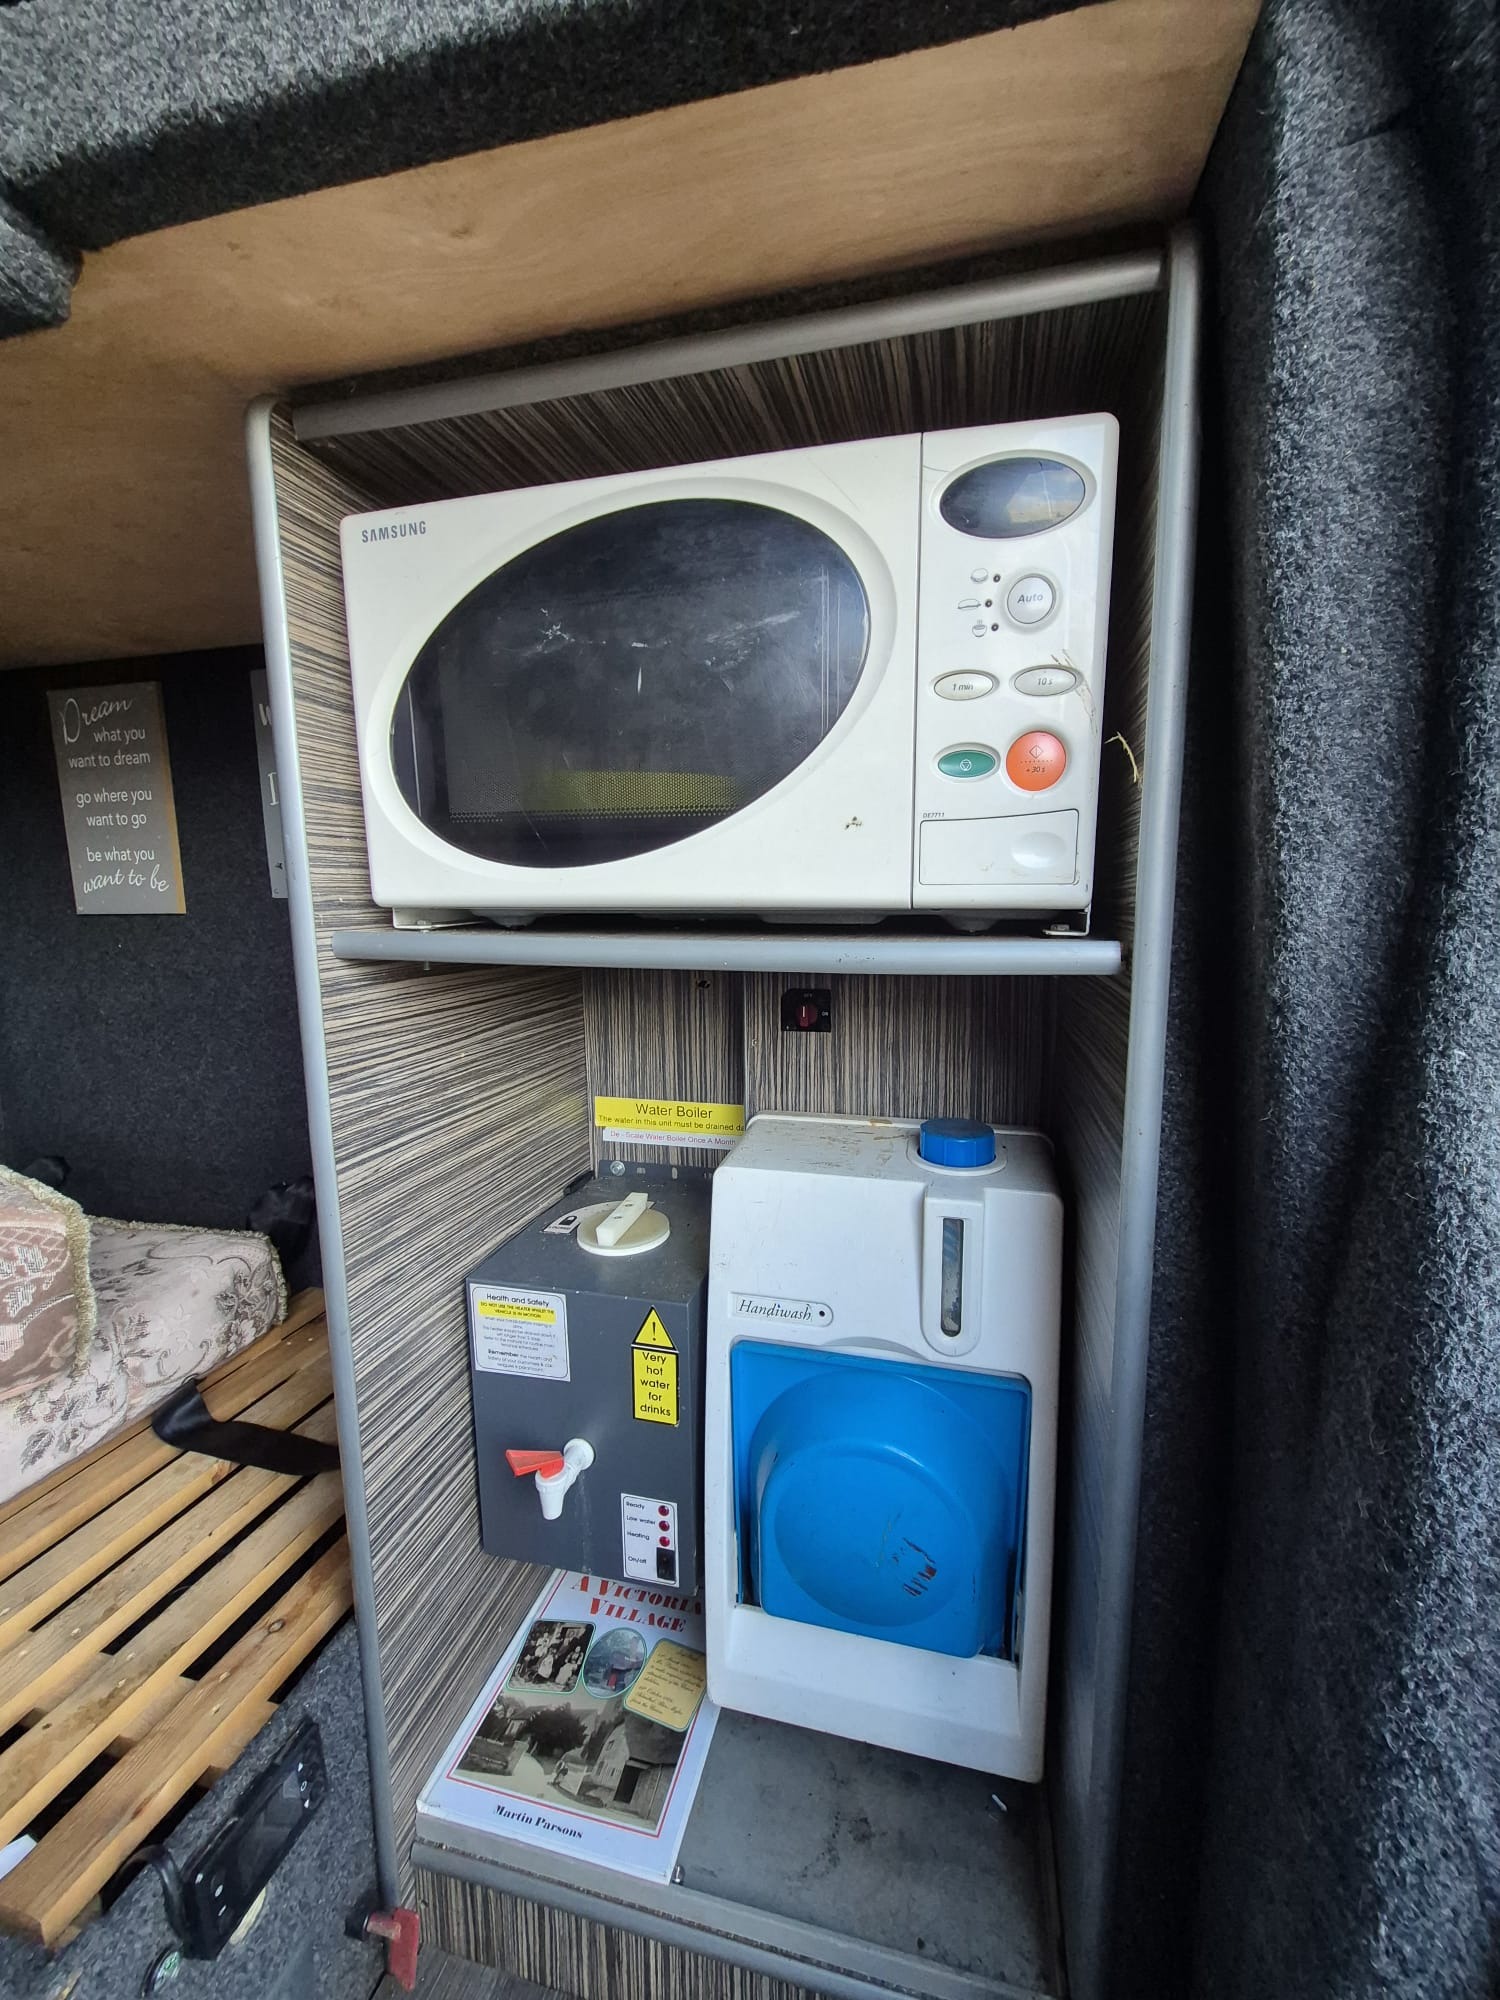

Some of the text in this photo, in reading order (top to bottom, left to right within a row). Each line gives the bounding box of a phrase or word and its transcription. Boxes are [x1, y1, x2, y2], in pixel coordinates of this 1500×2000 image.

[362, 520, 426, 543] SAMSUNG
[1017, 593, 1044, 604] Auto
[958, 683, 974, 692] min
[1038, 677, 1046, 686] 10
[59, 698, 133, 744] Dream
[93, 727, 146, 744] what you
[68, 748, 151, 768] want to dream
[76, 787, 152, 808] go where you
[86, 812, 147, 828] want to go
[86, 845, 155, 864] be what you
[83, 864, 170, 894] want to be
[636, 1103, 713, 1118] Water Boiler
[599, 1115, 612, 1123] The
[614, 1116, 634, 1124] water
[644, 1118, 656, 1126] this
[706, 1122, 734, 1131] drained
[646, 1133, 665, 1141] Water
[667, 1134, 686, 1142] Boiler
[688, 1136, 706, 1144] Once
[714, 1138, 736, 1146] Month
[486, 1293, 549, 1308] Health and Safety
[739, 1299, 812, 1320] Handiwash
[642, 1352, 666, 1364] Very
[646, 1366, 663, 1375] hot
[640, 1379, 670, 1390] water
[648, 1392, 662, 1401] for
[640, 1404, 671, 1417] drinks
[626, 1501, 645, 1510] Ready
[626, 1531, 650, 1540] Heating
[628, 1556, 647, 1564] On/off
[570, 1576, 589, 1592] A
[590, 1597, 687, 1632] VILLAGE
[494, 1805, 583, 1838] Martin Parsons
